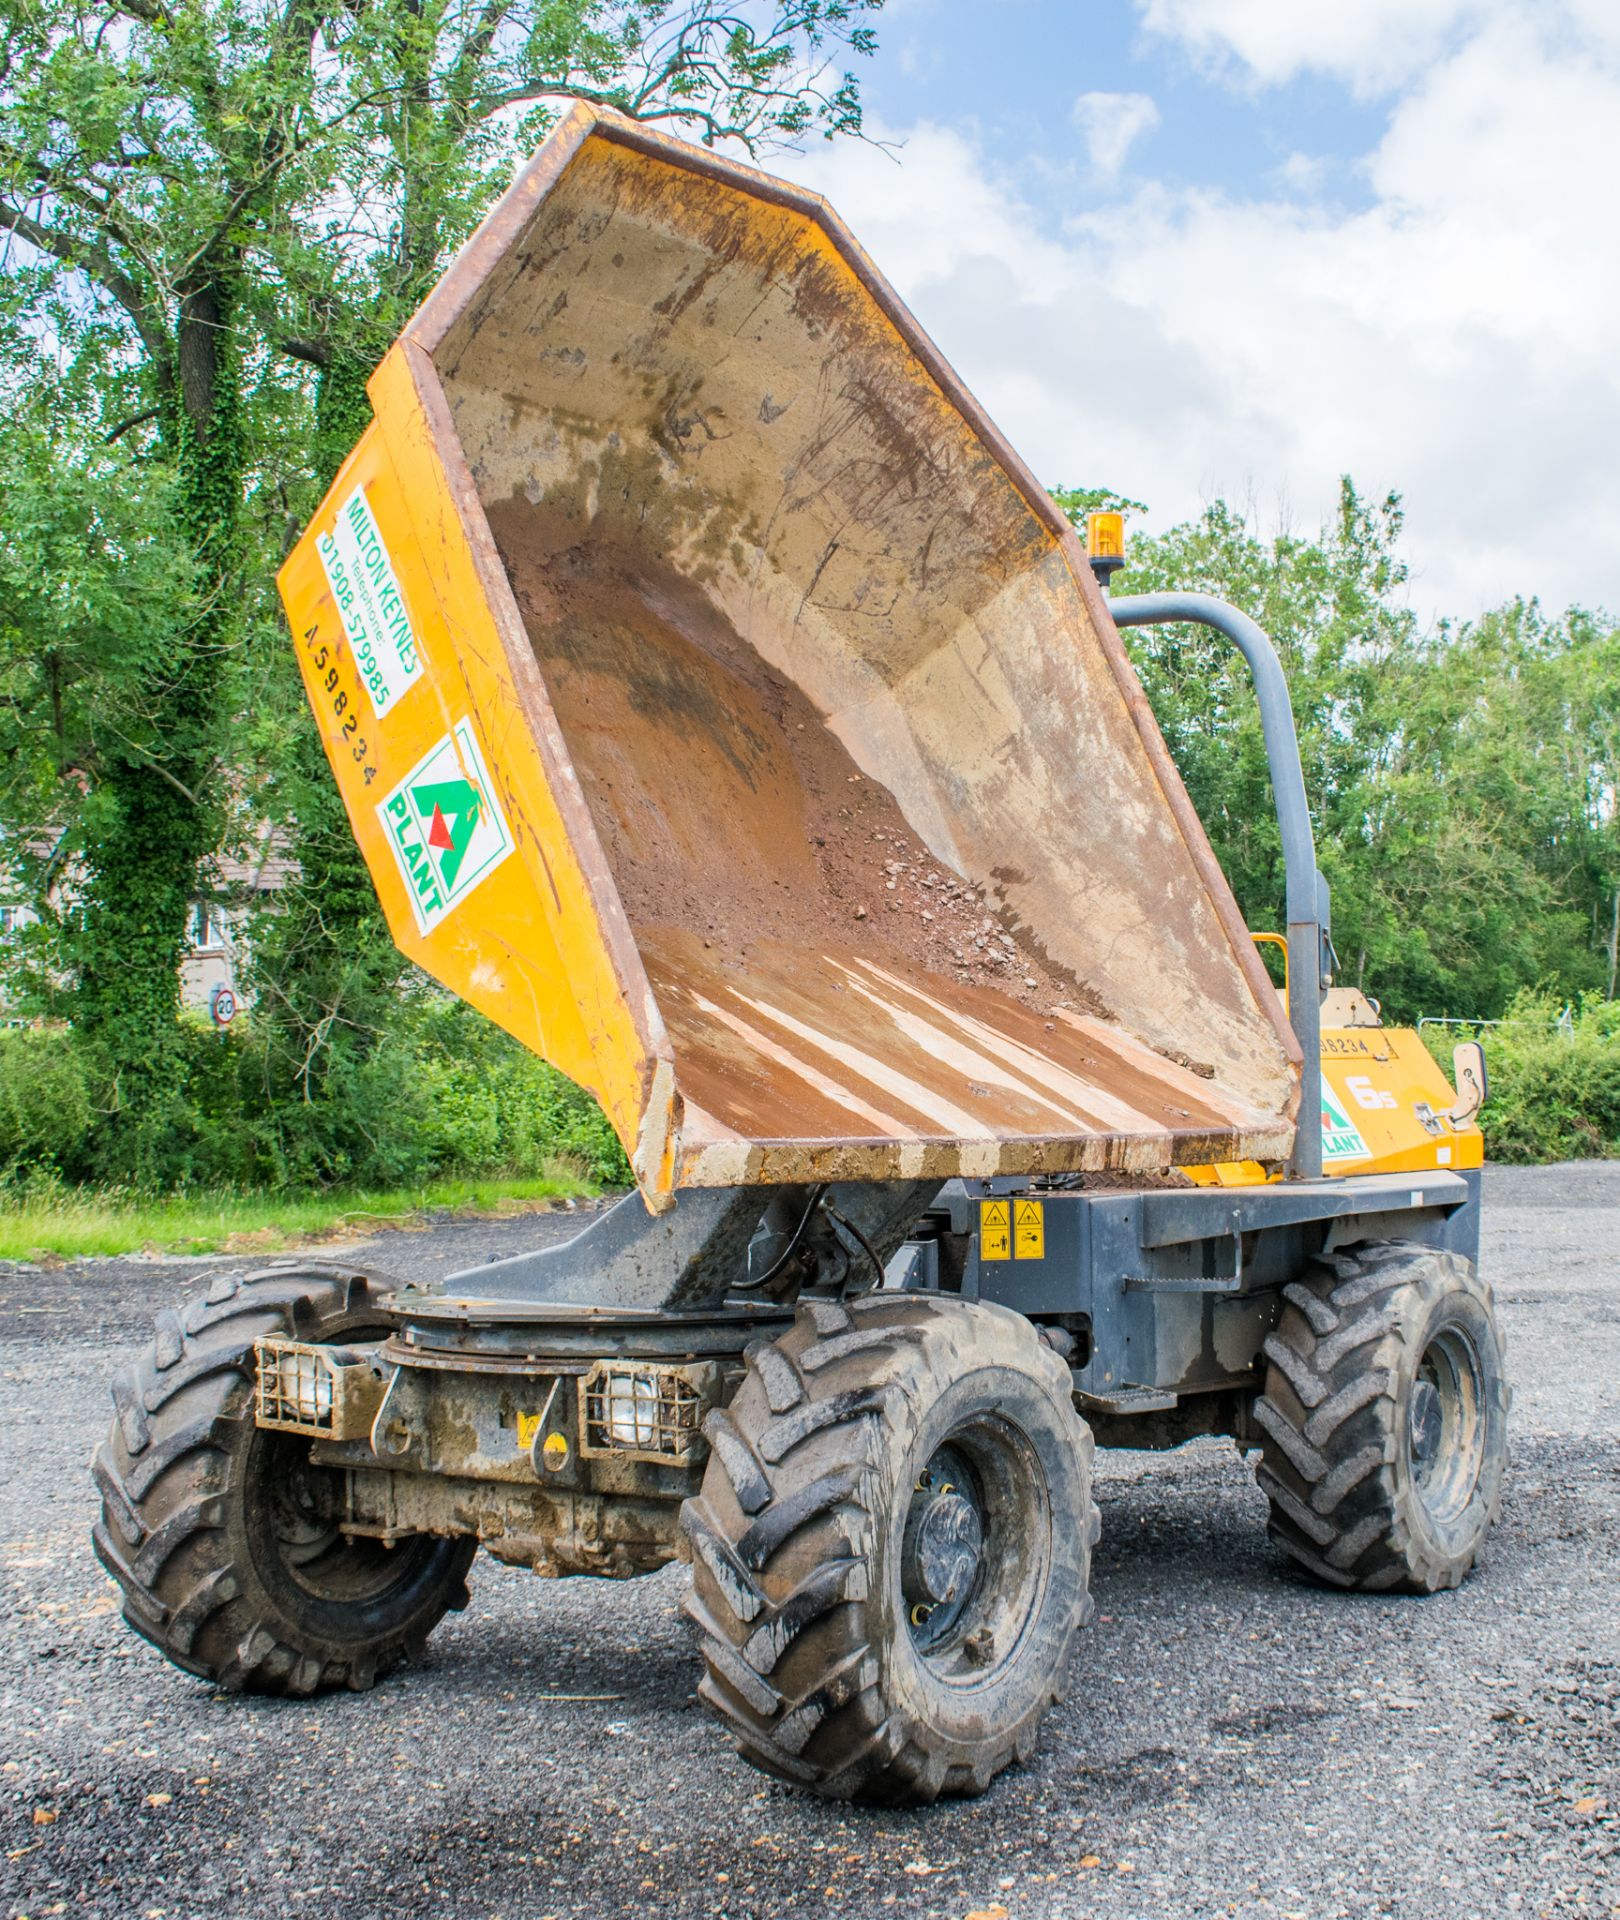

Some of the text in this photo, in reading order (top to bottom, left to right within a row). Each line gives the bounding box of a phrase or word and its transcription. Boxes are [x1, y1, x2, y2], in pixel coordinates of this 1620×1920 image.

[321, 534, 390, 705] 01908-579985
[346, 496, 417, 674] MILTON KEYNES
[350, 554, 386, 647] Telephone:
[387, 792, 444, 914] PLANT
[218, 1000, 233, 1014] 20
[1320, 1038, 1368, 1053] 98234
[1321, 1134, 1364, 1154] LANT
